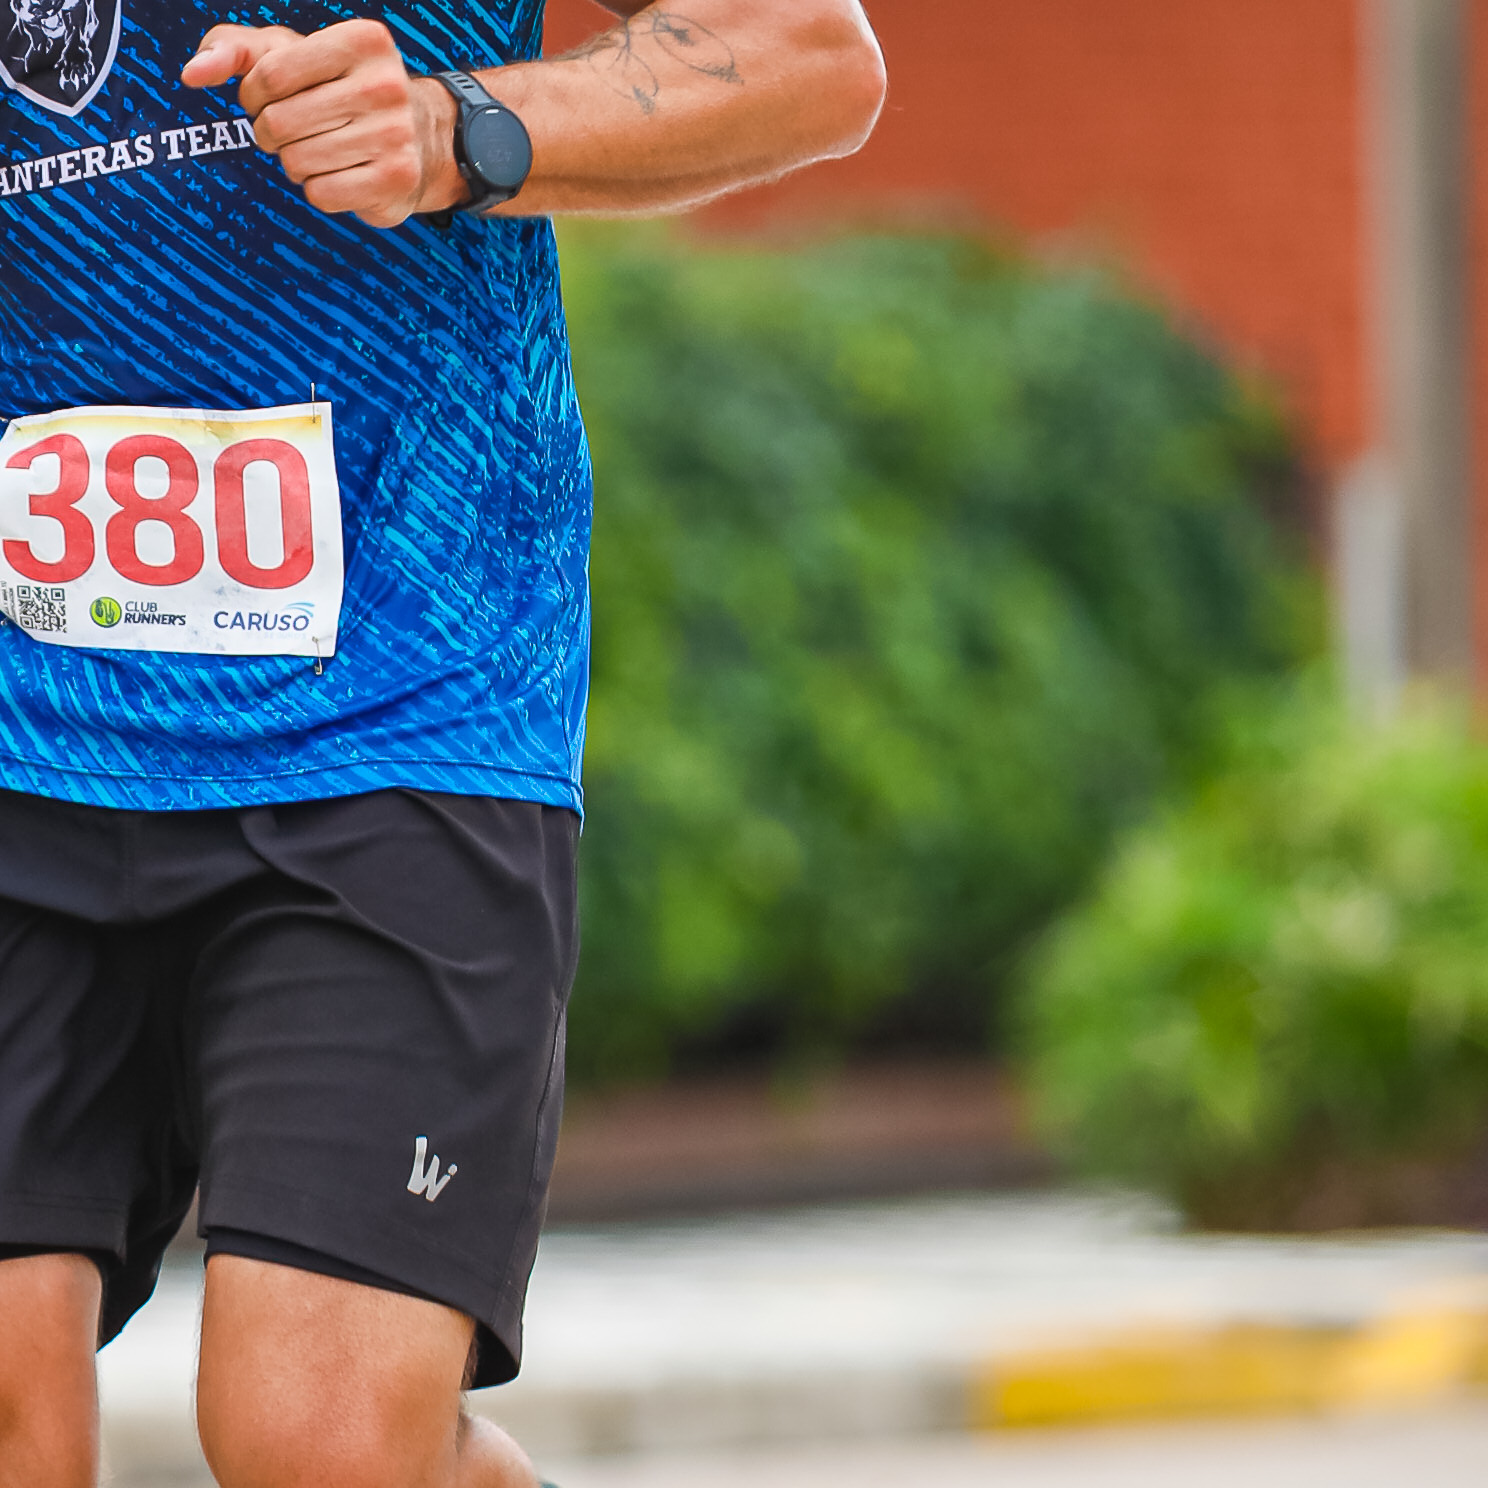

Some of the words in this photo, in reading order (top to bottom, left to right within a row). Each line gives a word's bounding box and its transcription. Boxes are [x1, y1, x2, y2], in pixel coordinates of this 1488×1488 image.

[1, 432, 314, 590] 380
[124, 600, 158, 612] CLUB
[123, 613, 187, 626] RUNNER'S
[213, 611, 310, 632] CARUSO
